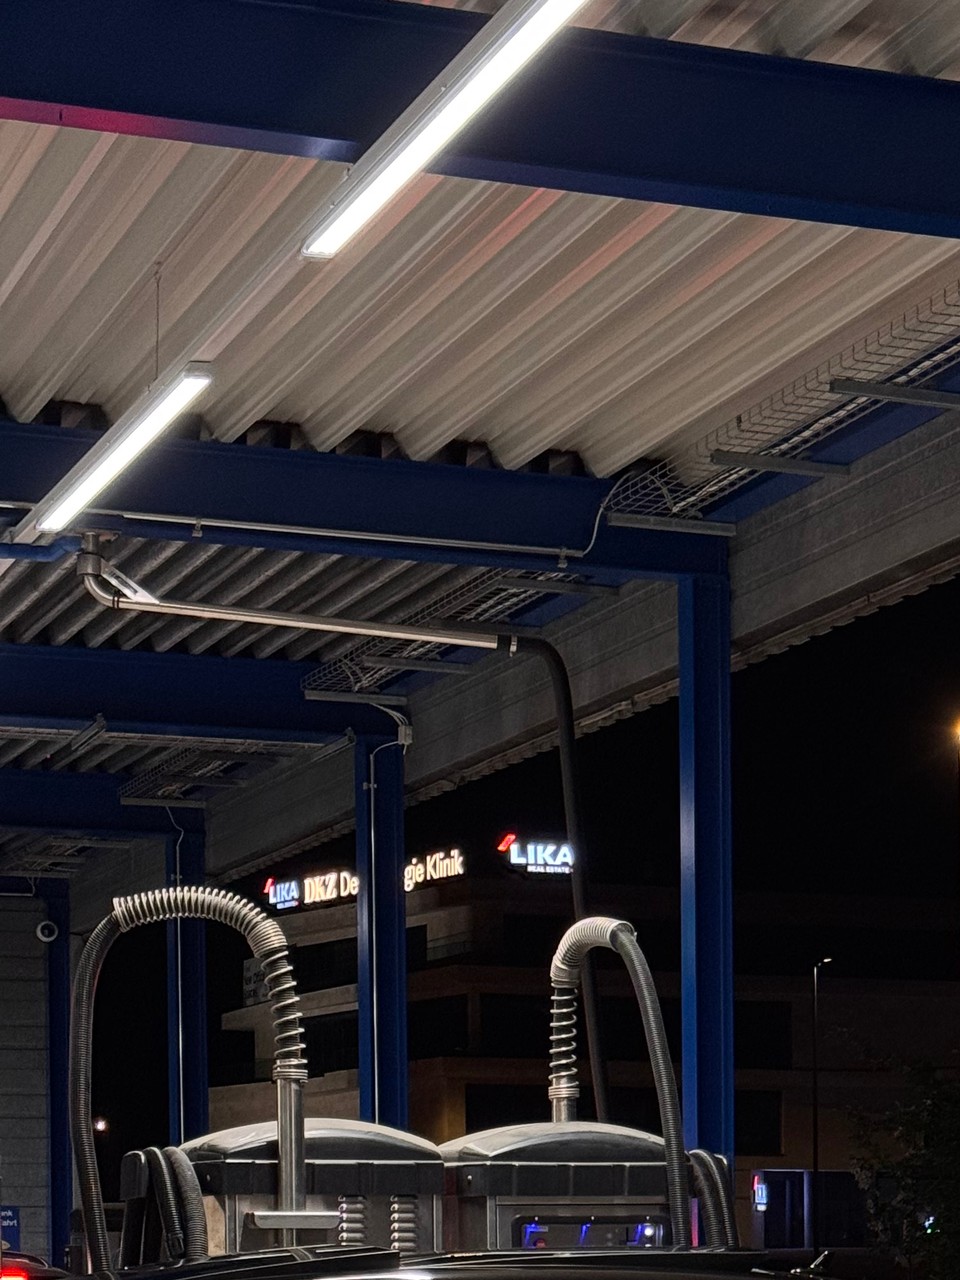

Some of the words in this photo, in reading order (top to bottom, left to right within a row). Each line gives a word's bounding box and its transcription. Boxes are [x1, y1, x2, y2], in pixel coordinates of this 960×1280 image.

[510, 842, 574, 866] LIKA
[304, 872, 338, 904] DKZ
[426, 849, 464, 881] Klinik
[269, 880, 299, 904] LIKA
